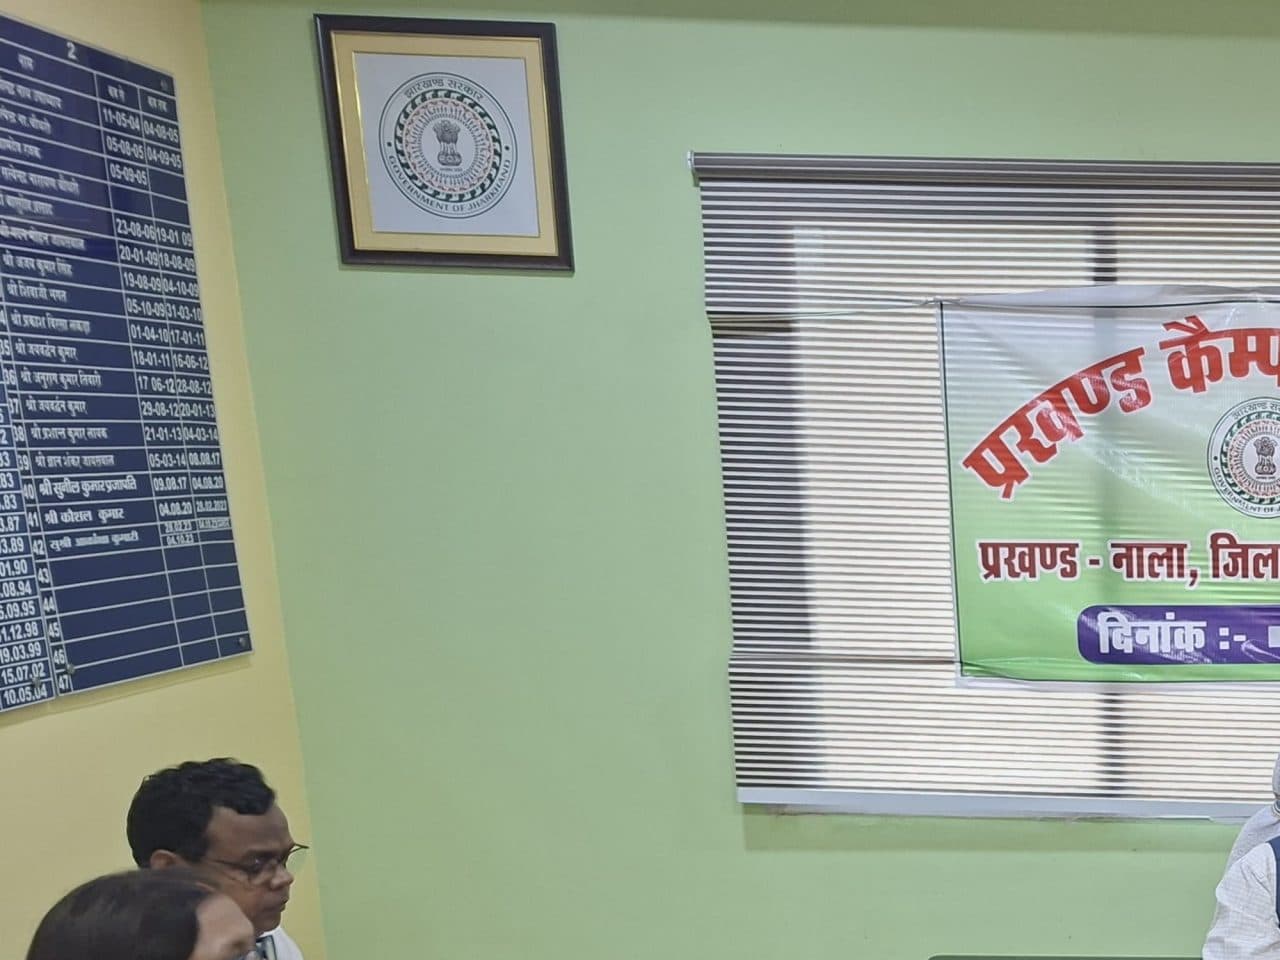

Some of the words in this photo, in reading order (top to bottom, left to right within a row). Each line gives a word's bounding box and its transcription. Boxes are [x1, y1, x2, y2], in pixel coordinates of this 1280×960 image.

[66, 41, 78, 60] 2
[447, 79, 485, 101] सरकार
[134, 350, 171, 367] 18-01-11
[3, 368, 17, 385] 36
[20, 366, 32, 383] श्री
[25, 394, 37, 411] श्री
[31, 422, 41, 439] श्री
[144, 426, 182, 441] 21-01-13
[962, 347, 1152, 498] प्रखण्ड
[35, 451, 46, 468] श्री
[149, 452, 187, 468] 05-03-14
[23, 484, 35, 500] 40
[39, 478, 53, 495] श्री
[53, 476, 80, 499] सुनील
[80, 480, 105, 497] कुमार
[153, 477, 187, 491] 09.08.17
[27, 512, 39, 527] 41
[44, 509, 58, 524] श्री
[98, 508, 125, 523] कुमार
[0, 537, 24, 554] 3.89
[32, 539, 45, 556] 42
[979, 542, 1079, 579] प्रखण्ड
[1110, 542, 1198, 587] नाला,
[38, 568, 49, 583] 43
[43, 596, 55, 612] 44
[0, 622, 39, 642] 1.12.98
[48, 622, 59, 637] 45
[1096, 611, 1207, 654] दिनांक
[0, 642, 41, 664] 19.03.99
[54, 649, 65, 664] 46
[1, 662, 46, 685] 15.07.02
[59, 675, 69, 690] 47
[3, 683, 47, 705] 10.05.04
